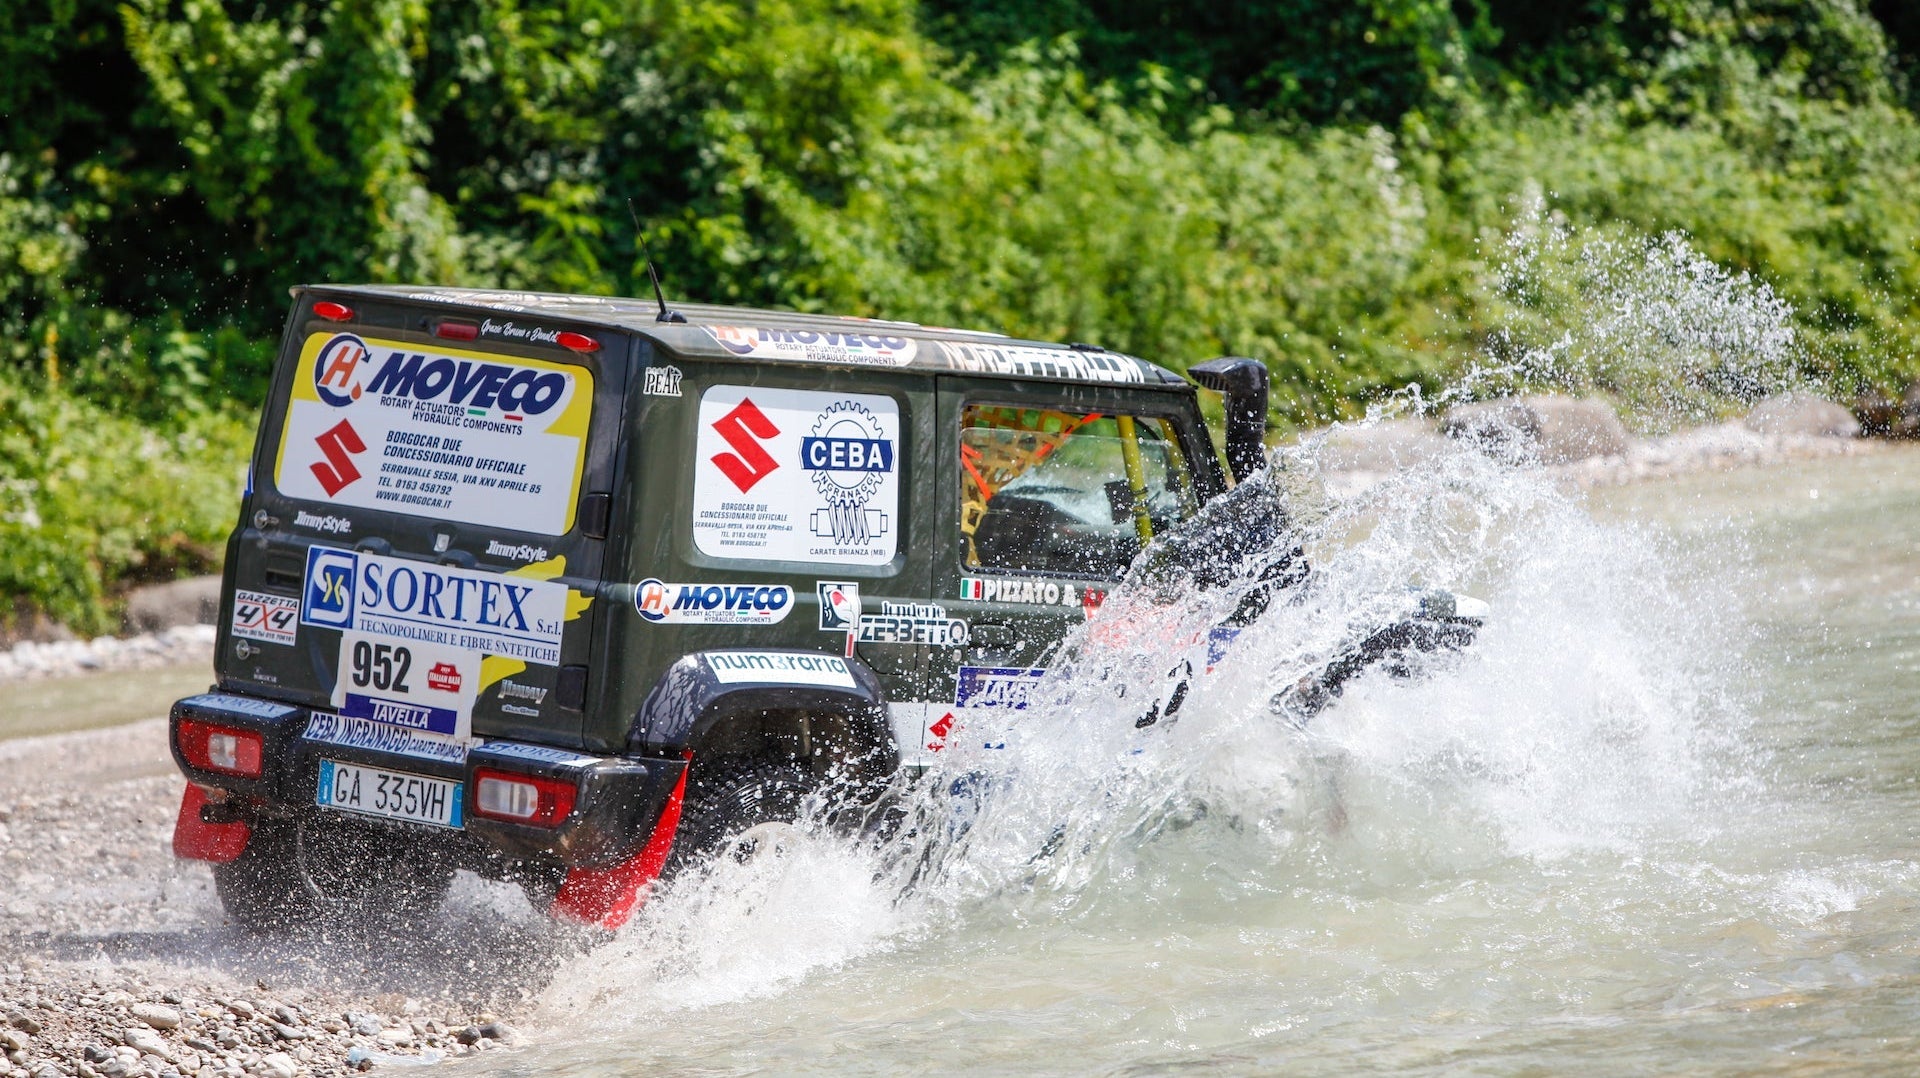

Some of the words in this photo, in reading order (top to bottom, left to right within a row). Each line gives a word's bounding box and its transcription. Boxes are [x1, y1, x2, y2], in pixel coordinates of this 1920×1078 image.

[806, 352, 847, 362] HYDRAULIC
[848, 354, 897, 366] COMPONENTS
[365, 352, 566, 415] MOVECO
[646, 367, 681, 394] PEAK
[380, 396, 412, 410] ROTARY
[415, 402, 465, 417] ACTUATORS
[412, 411, 461, 427] HYDRAULIC
[463, 418, 523, 436] COMPONENTS
[386, 430, 440, 449] BORGOCAR
[442, 438, 463, 452] DUE
[383, 445, 474, 468] CONCESSIONARIO
[475, 457, 527, 475] UFFICIALE
[809, 440, 884, 469] CEBA
[377, 476, 393, 487] TEL.
[395, 479, 417, 490] 0163
[419, 482, 452, 496] 458792
[380, 463, 432, 478] SERRAVALLE
[432, 470, 459, 483] SESIA,
[463, 474, 477, 485] VIA
[479, 476, 497, 488] XXV
[498, 479, 529, 492] APRILE
[529, 484, 542, 494] 85
[818, 471, 876, 499] INGRANAGGI
[375, 490, 452, 509] WWW.BORGOCAR.IT
[721, 502, 755, 512] BORGOCAR
[756, 504, 768, 512] DUE
[700, 511, 756, 520] CONCESSIONARIO
[757, 513, 788, 522] UFFICIALE
[809, 548, 836, 556] CARATE
[838, 548, 869, 556] BRIANZA
[237, 592, 298, 609] GAZZETTA
[361, 562, 534, 632] SORTEX
[537, 619, 561, 636] S.r.l.
[672, 586, 788, 610] MOVECO
[984, 579, 1060, 604] PIZZATO
[360, 618, 447, 643] TECNOPOLIMERI
[450, 634, 457, 645] E
[460, 635, 493, 651] FIBRE
[352, 641, 412, 694] 952
[369, 699, 432, 729] TAVELLA
[306, 713, 339, 740] CEBA
[337, 718, 411, 752] INGRANAGGI
[335, 767, 360, 806] GA
[375, 774, 446, 820] 335VH
